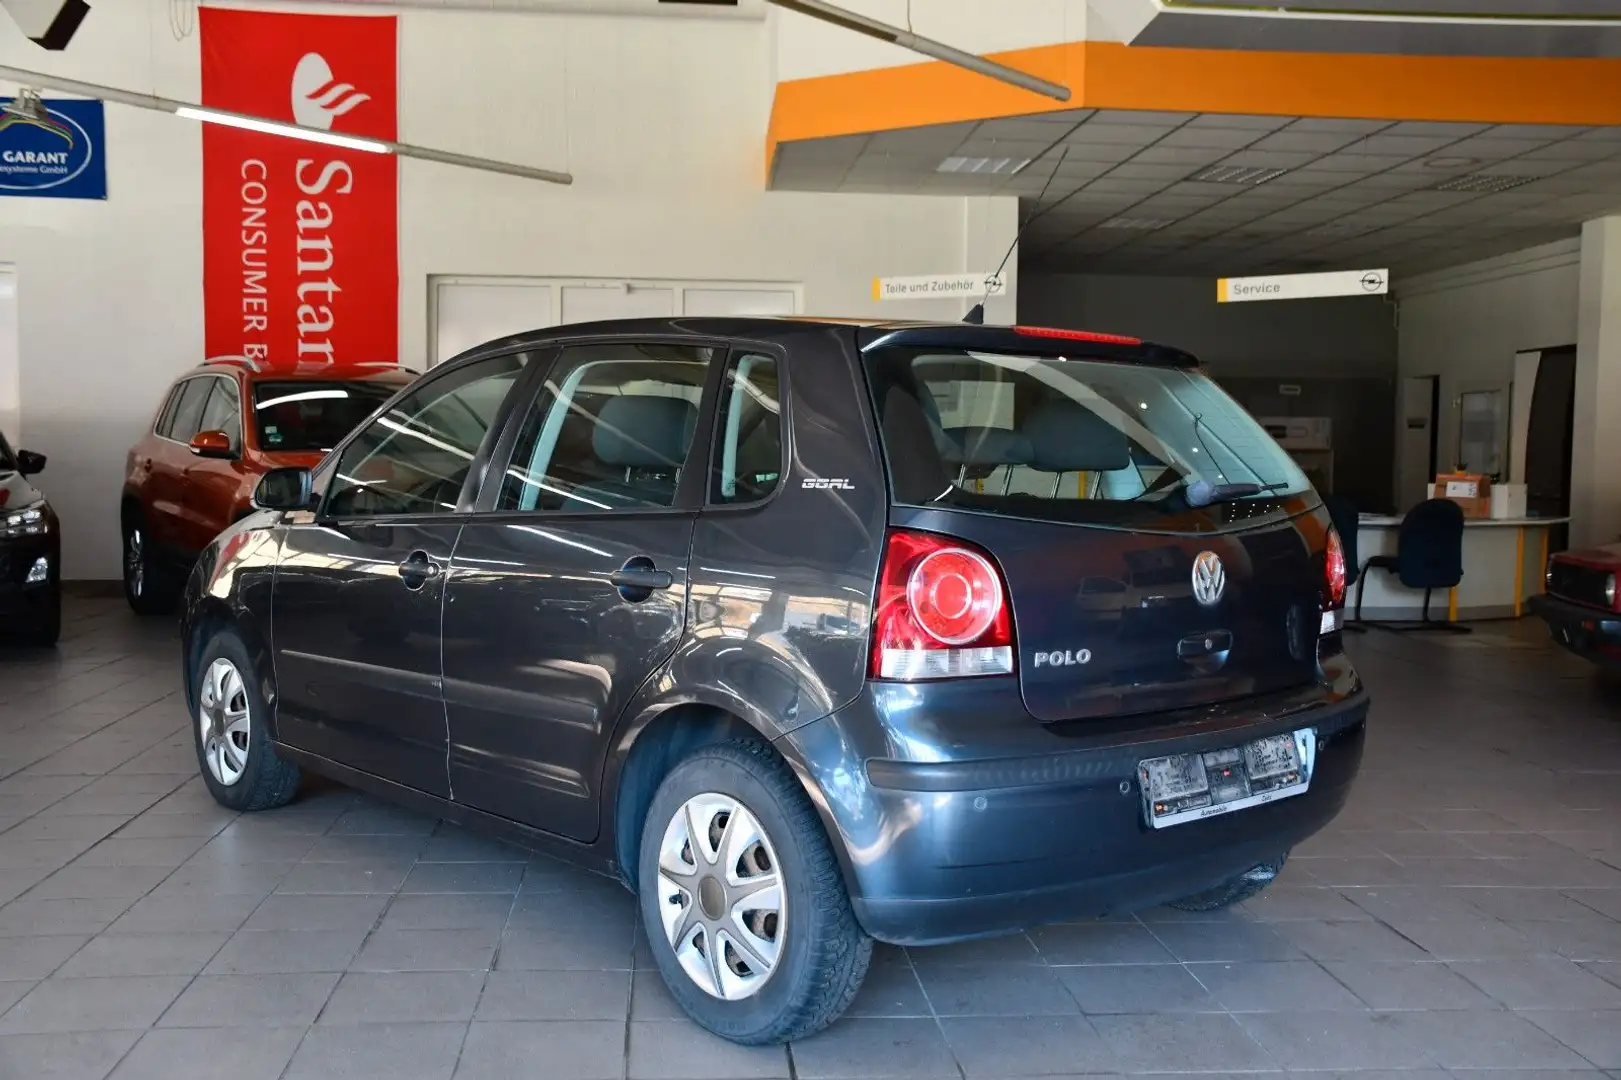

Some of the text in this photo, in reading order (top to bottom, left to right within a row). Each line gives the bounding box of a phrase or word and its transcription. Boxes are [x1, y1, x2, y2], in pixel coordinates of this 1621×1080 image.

[2, 150, 69, 165] GARANT
[241, 158, 268, 333] CONSUMER
[885, 280, 974, 294] Teile und Zubehör
[1233, 282, 1281, 295] Service
[801, 478, 855, 490] GOAL
[1034, 648, 1092, 668] POLO
